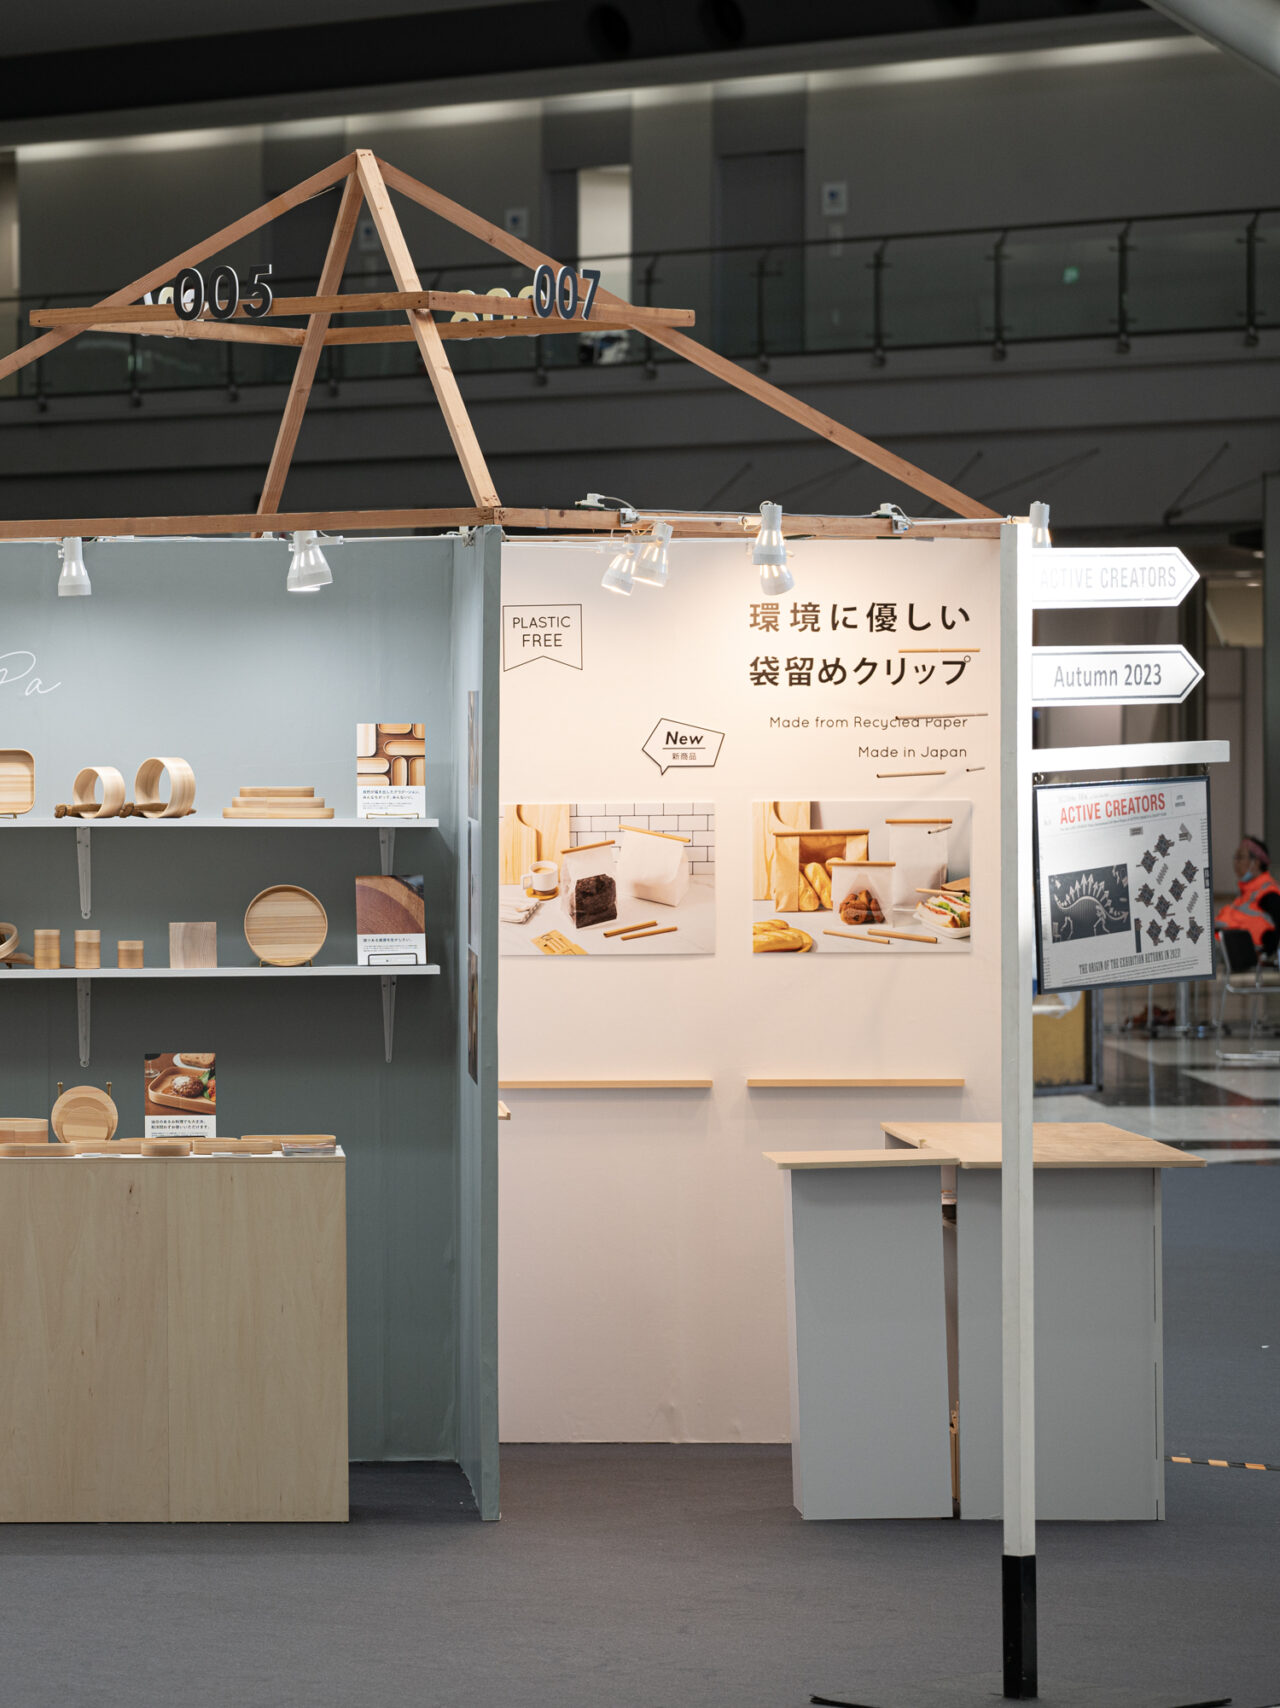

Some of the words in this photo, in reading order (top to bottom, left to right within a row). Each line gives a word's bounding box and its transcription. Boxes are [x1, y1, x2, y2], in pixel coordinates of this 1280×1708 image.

[173, 263, 273, 321] 005
[533, 264, 601, 320] 007
[1040, 567, 1093, 589] ACTIVE
[1100, 566, 1177, 589] CREATORS
[512, 615, 571, 629] PLASTIC
[749, 601, 971, 633] 環境に優しい
[522, 633, 563, 647] FREE
[749, 655, 971, 687] 袋留めクリップ
[1054, 665, 1118, 688] Autumn
[1124, 663, 1162, 686] 2023
[769, 716, 810, 729] Made
[815, 716, 849, 728] from
[854, 716, 920, 730] Recycled
[925, 717, 969, 730] Paper
[665, 731, 704, 745] New
[672, 752, 697, 761] 新商品
[858, 746, 899, 758] Made
[903, 746, 916, 758] in
[920, 746, 967, 760] Japan
[1060, 802, 1102, 825] ACTIVE
[1105, 792, 1166, 819] CREATORS
